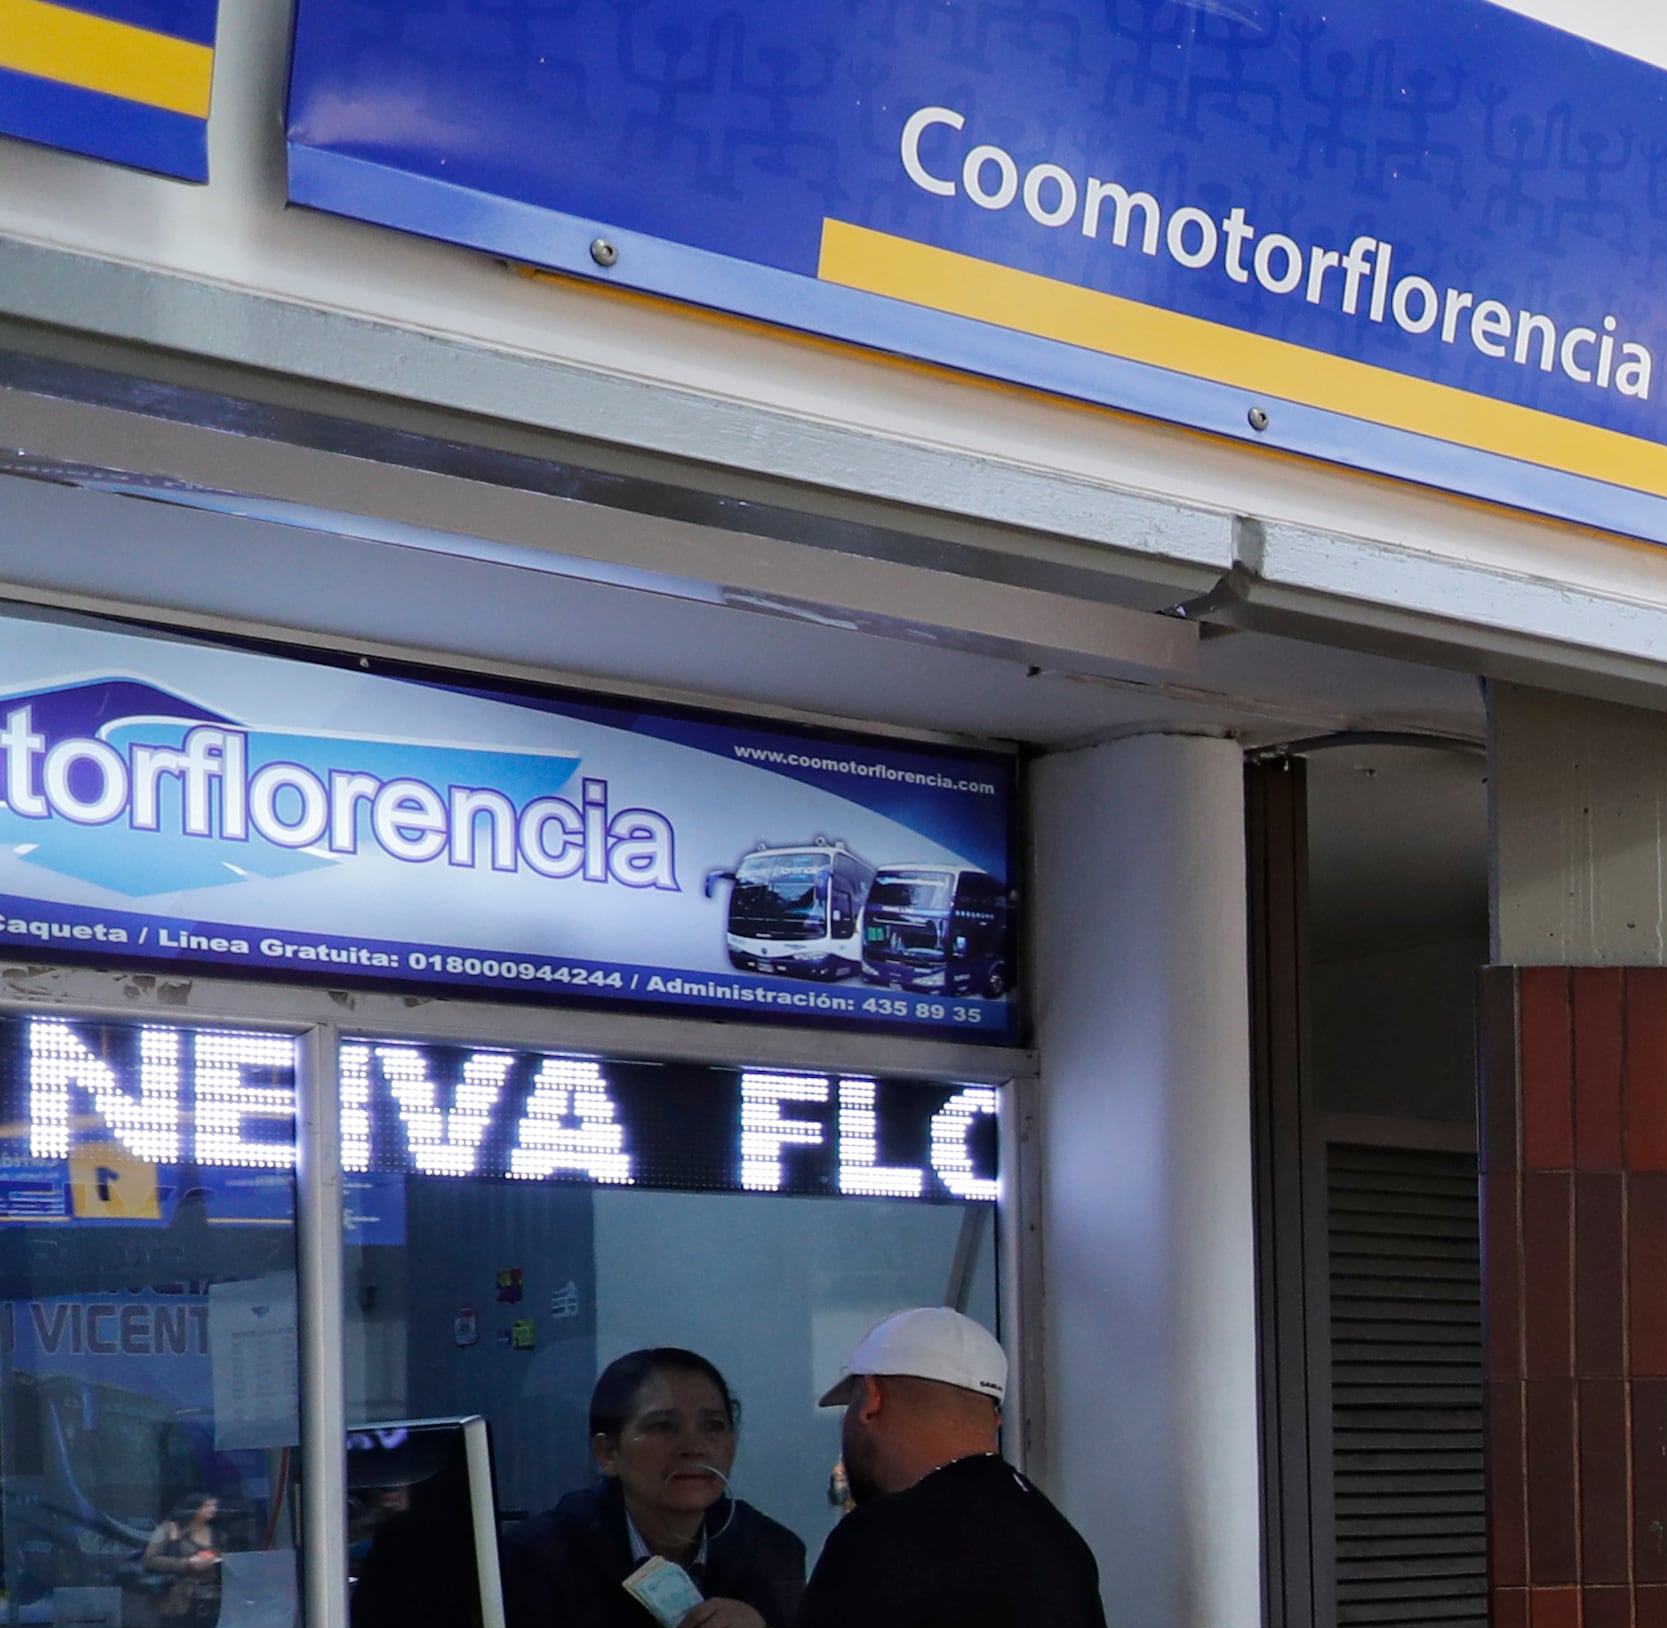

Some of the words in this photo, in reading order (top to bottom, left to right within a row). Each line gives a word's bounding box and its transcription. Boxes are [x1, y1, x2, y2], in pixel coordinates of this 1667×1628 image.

[901, 106, 1653, 401] Coomotorflorencia
[734, 744, 995, 796] www.coomotorflorencia.com
[137, 926, 148, 945] /
[157, 928, 250, 954] Linea
[259, 937, 400, 968] Gratuita:
[407, 951, 624, 990] 018000944244
[630, 973, 641, 991] /
[647, 974, 855, 1012] Administración:
[861, 996, 907, 1018] 435
[915, 1001, 946, 1021] 89
[952, 1004, 982, 1024] 35
[28, 1016, 637, 1185] NEIVA
